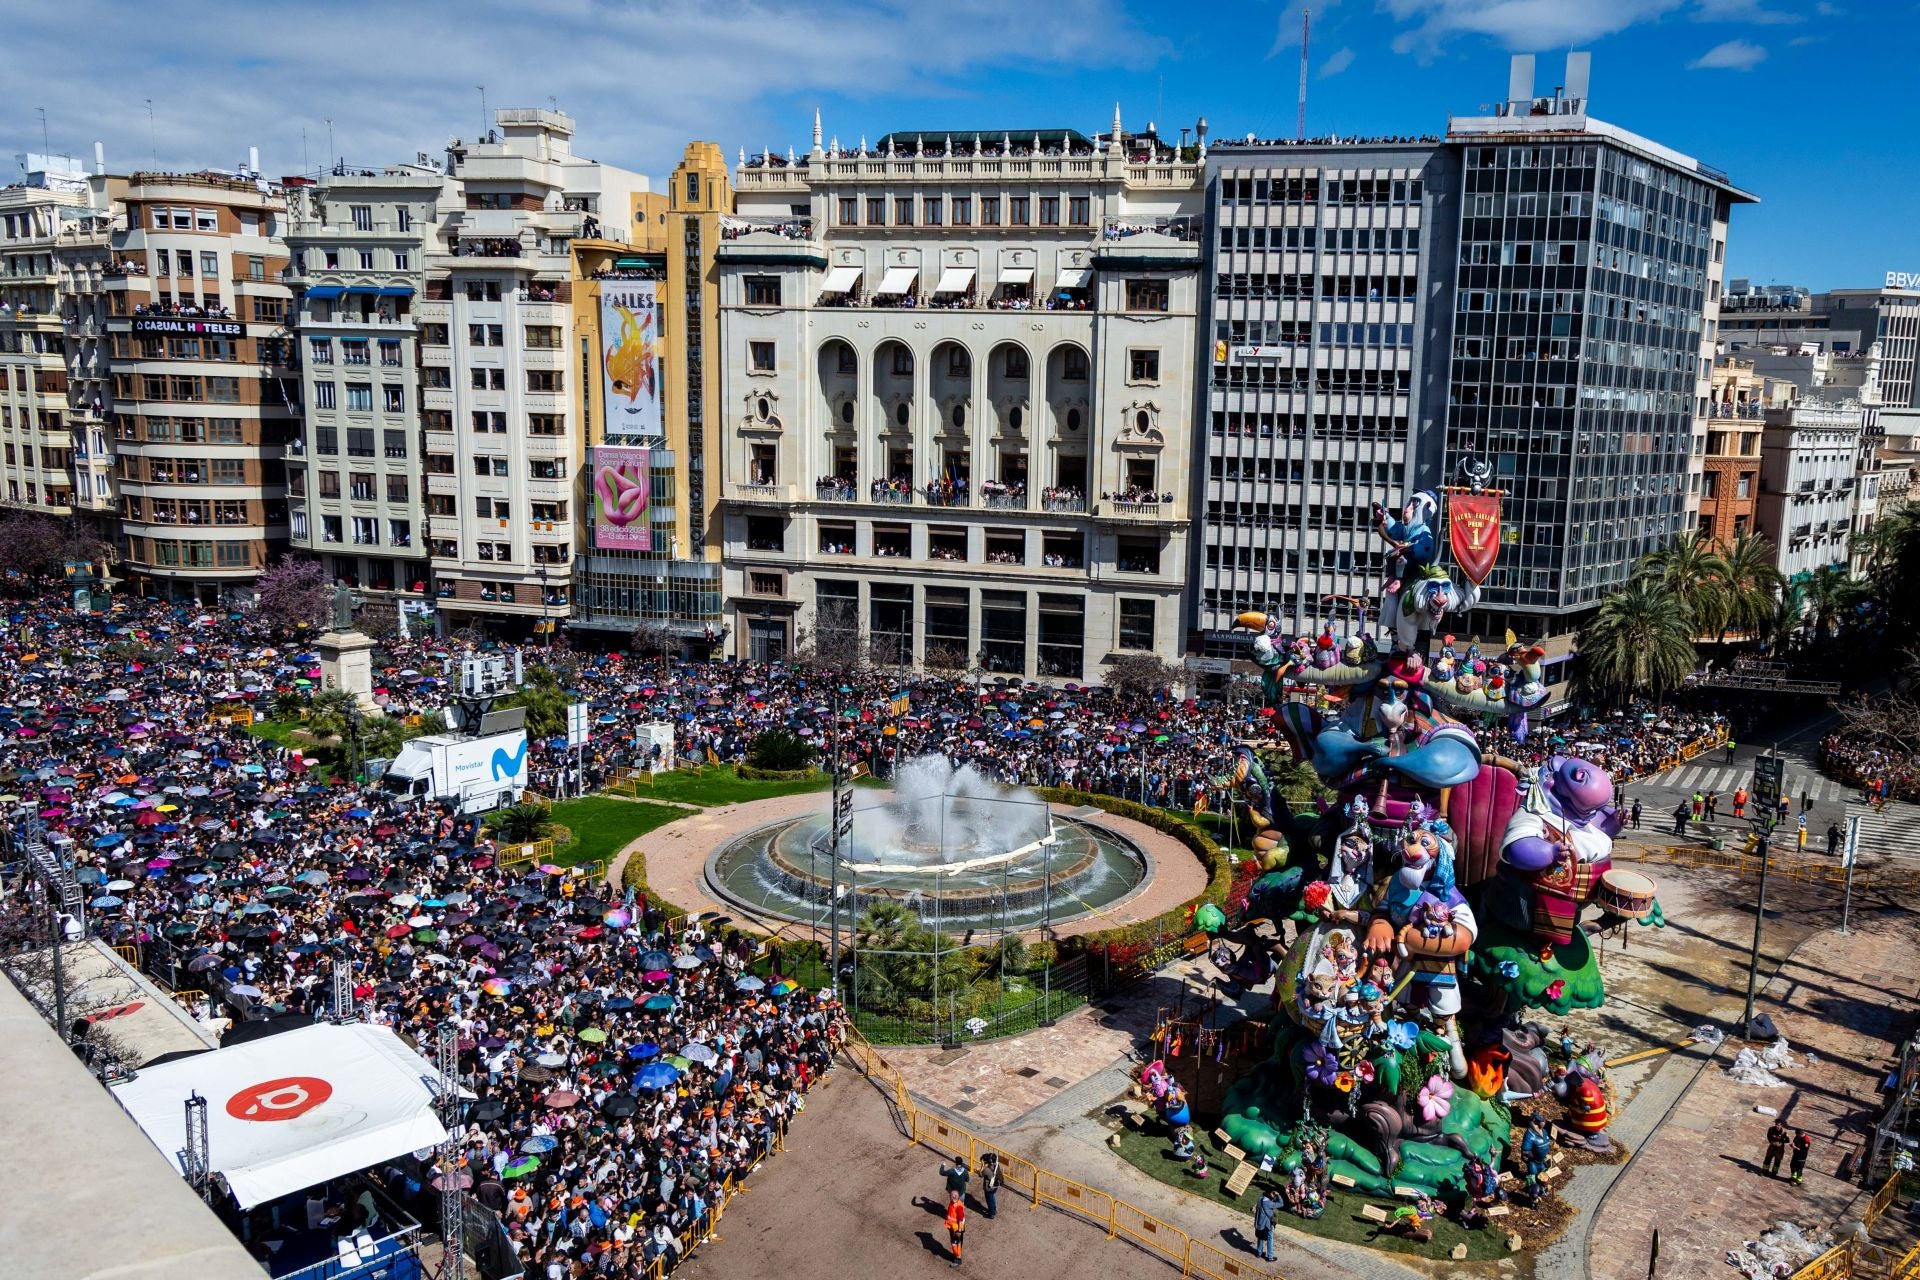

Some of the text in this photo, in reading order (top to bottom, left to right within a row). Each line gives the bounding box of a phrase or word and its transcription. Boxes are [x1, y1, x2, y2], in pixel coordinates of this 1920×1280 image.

[144, 320, 241, 334] CASUAL HOTELES
[629, 526, 646, 534] 2025
[1472, 528, 1479, 545] 1
[456, 761, 484, 772] Movistar
